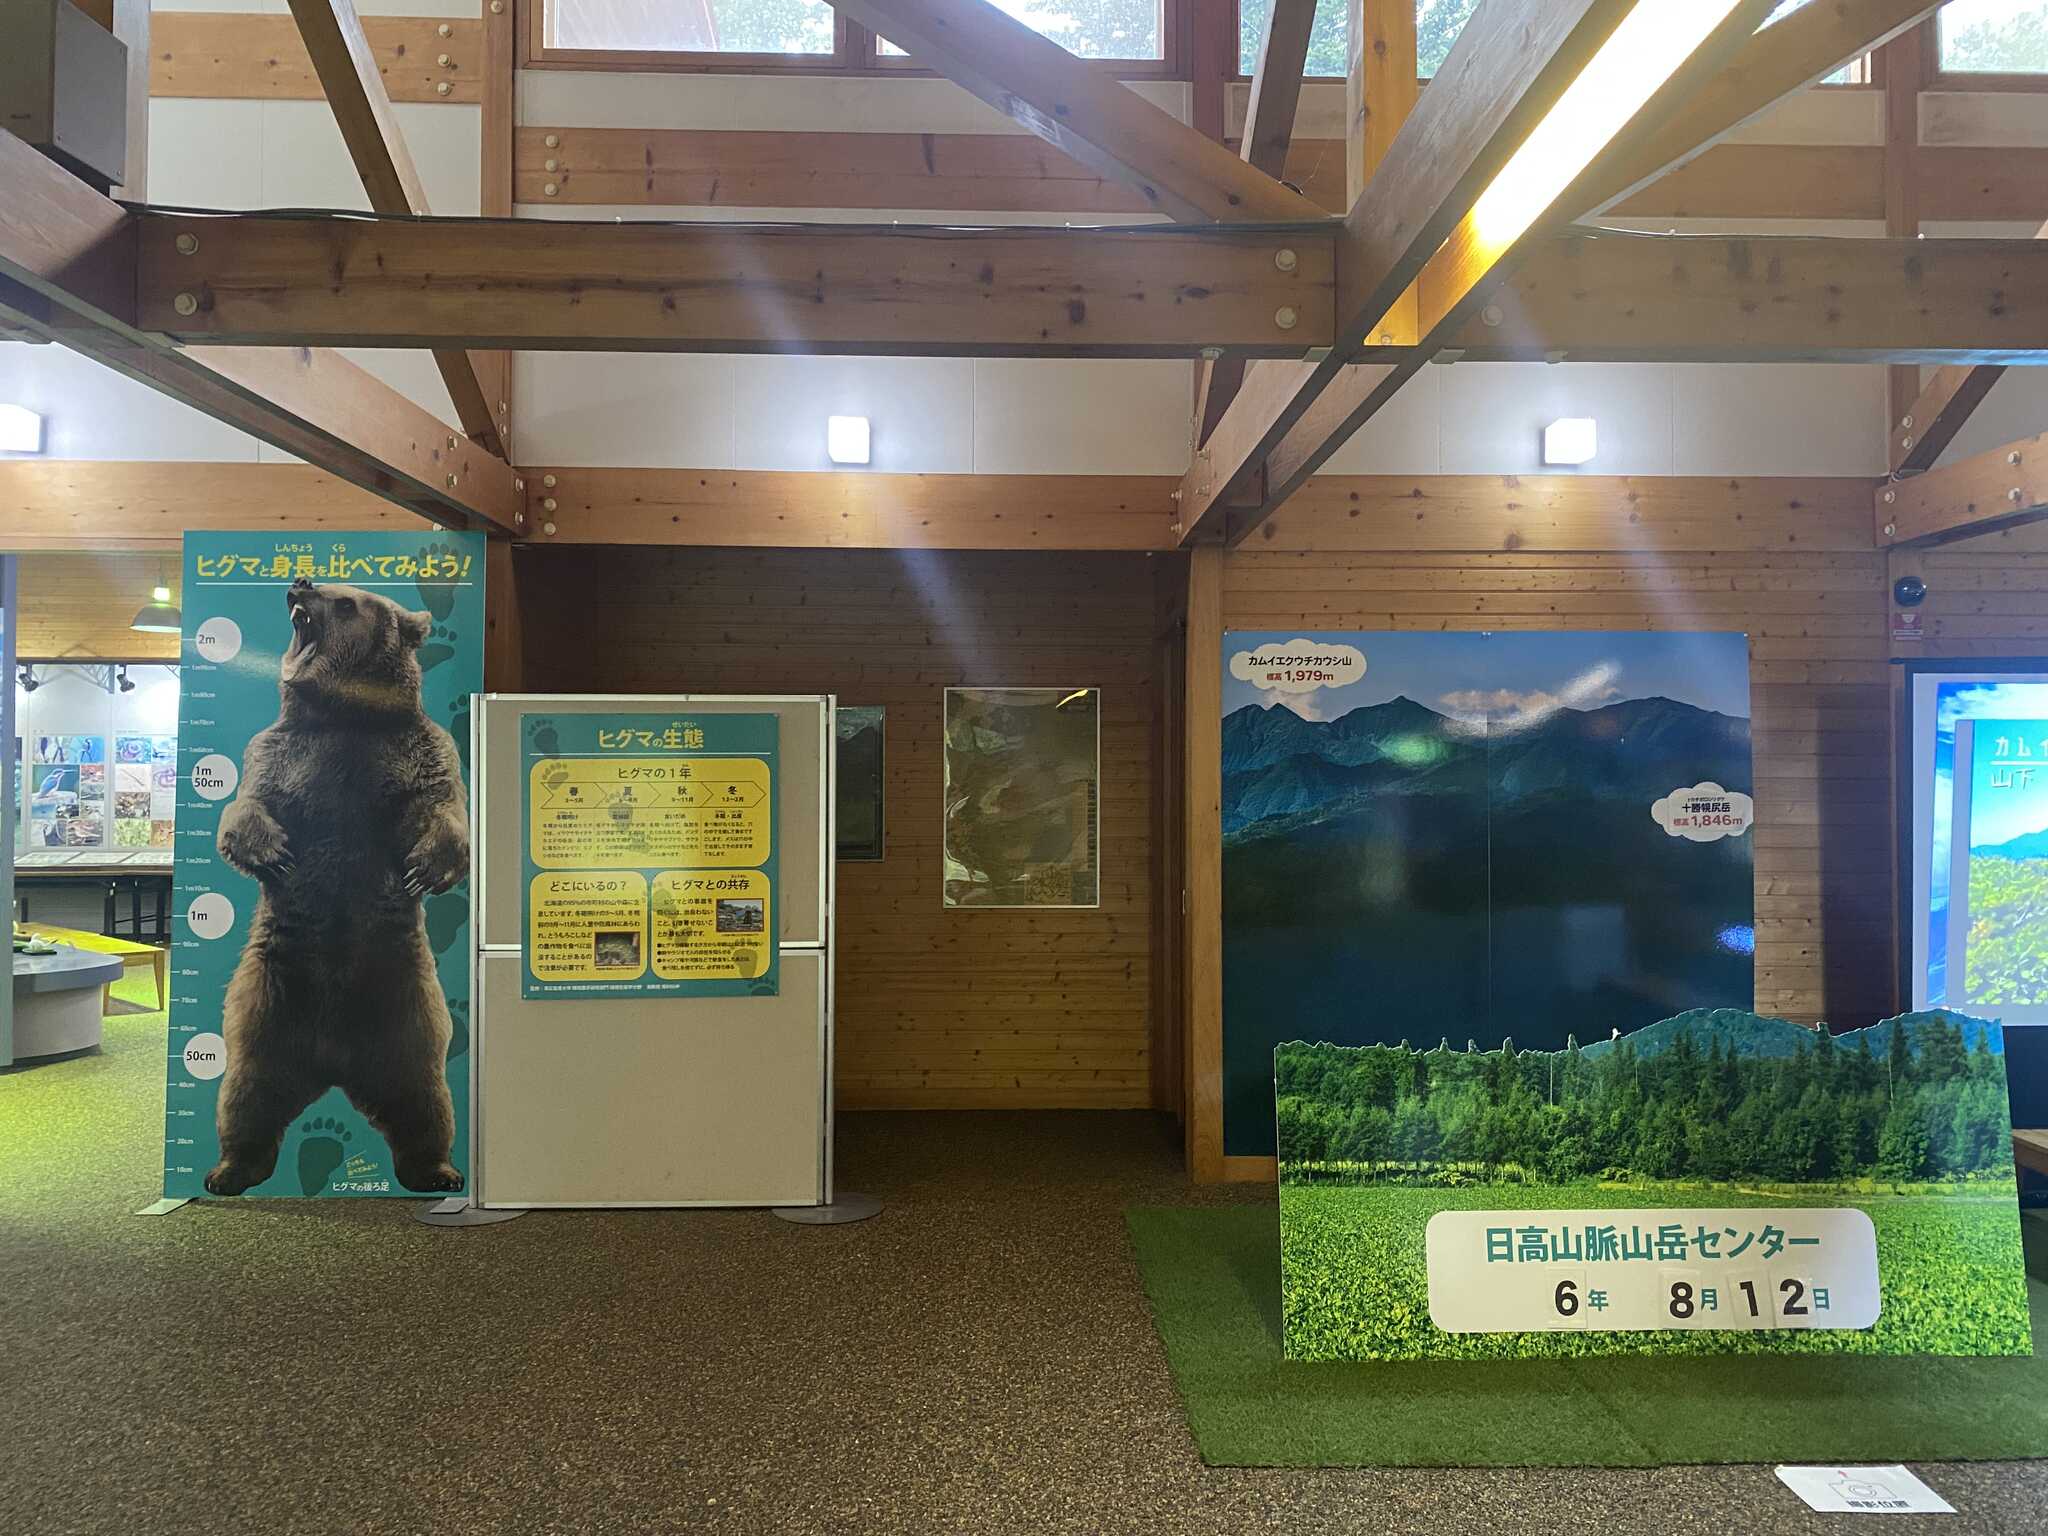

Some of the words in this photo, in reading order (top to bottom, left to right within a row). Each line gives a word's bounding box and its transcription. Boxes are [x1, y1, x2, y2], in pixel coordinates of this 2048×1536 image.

[274, 543, 313, 552] しんちょう
[332, 543, 346, 552] くら
[196, 554, 473, 578] ヒグマと身長を比べてみよう！
[198, 634, 216, 645] 2m
[1248, 656, 1352, 666] カムイエクウチカウシ山
[599, 728, 704, 749] ヒグマの生態
[195, 766, 212, 776] 1m
[194, 778, 224, 788] 50cm
[550, 881, 627, 892] どこにいるの？
[672, 880, 750, 891] ヒグマとの共存
[191, 911, 208, 921] 1m
[186, 1051, 216, 1061] 50cm
[332, 1181, 390, 1192] ヒグマの後ろ足
[1486, 1224, 1820, 1263] 日高山脈山岳センター
